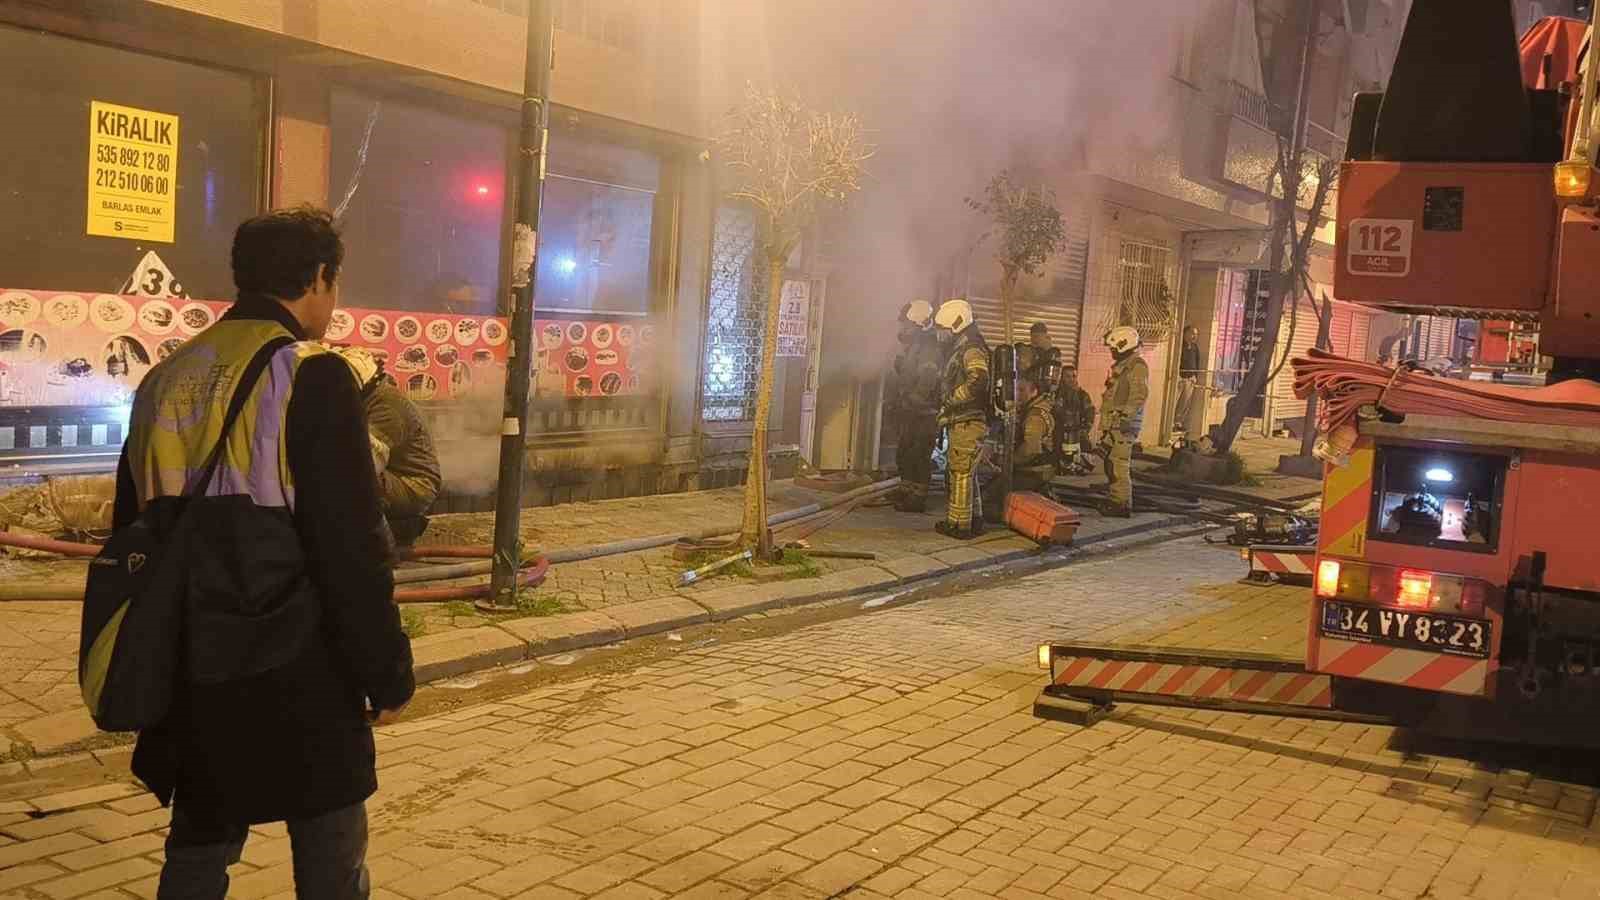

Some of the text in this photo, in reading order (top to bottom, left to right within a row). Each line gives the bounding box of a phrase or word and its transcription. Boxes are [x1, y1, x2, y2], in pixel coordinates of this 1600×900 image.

[97, 144, 170, 173] 535 892 12 80
[96, 168, 169, 195] 212 510 06 00
[102, 200, 134, 213] BARLAS
[1360, 225, 1401, 252] 112
[1340, 607, 1369, 633] 34
